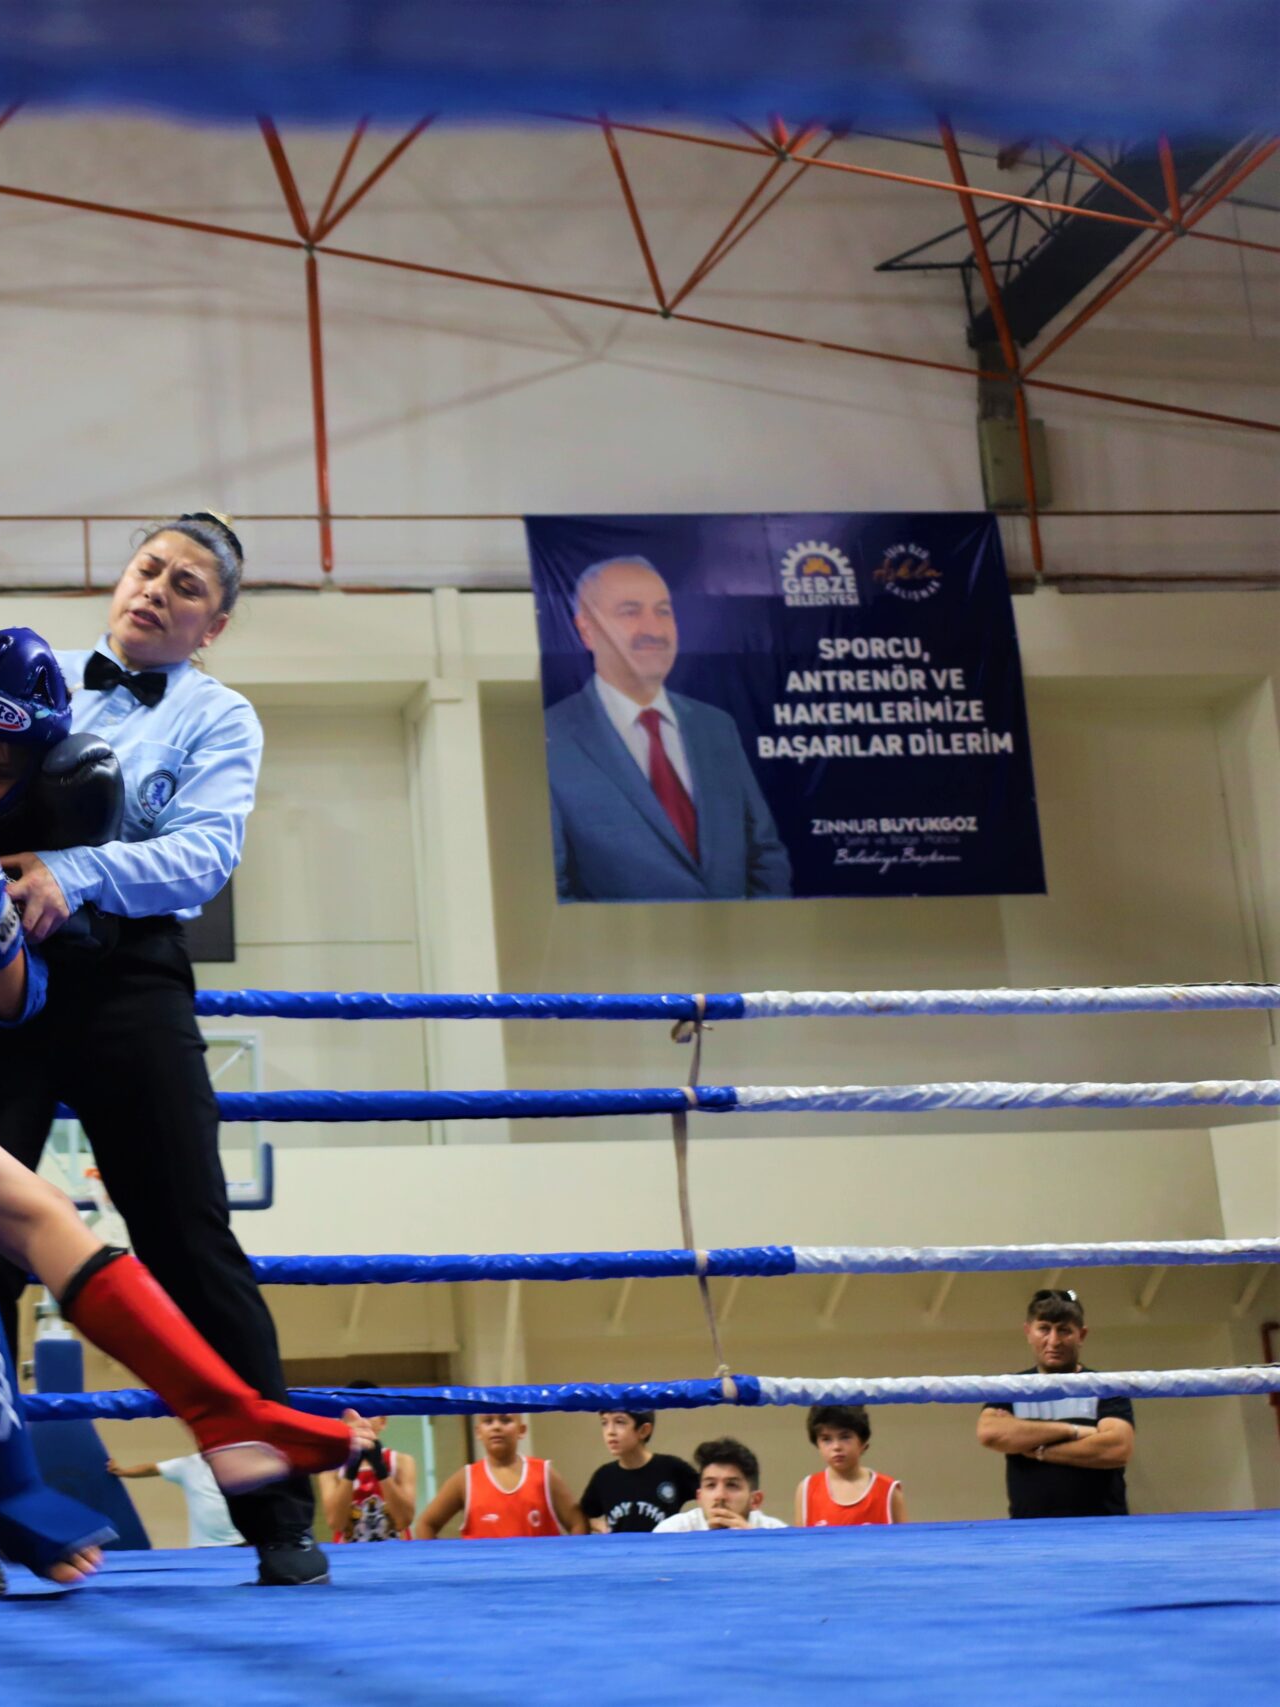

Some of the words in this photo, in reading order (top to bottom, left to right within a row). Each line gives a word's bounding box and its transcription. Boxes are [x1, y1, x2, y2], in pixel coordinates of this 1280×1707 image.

[782, 577, 857, 593] GEBZE
[818, 637, 930, 663] SPORCU,
[786, 664, 927, 692] ANTRENÖR
[930, 668, 966, 690] VE
[773, 696, 985, 725] HAKEMLERİMİZE
[757, 734, 904, 764] BAŞARILAR
[907, 728, 1014, 756] DİLERİM
[636, 1501, 666, 1522] THA
